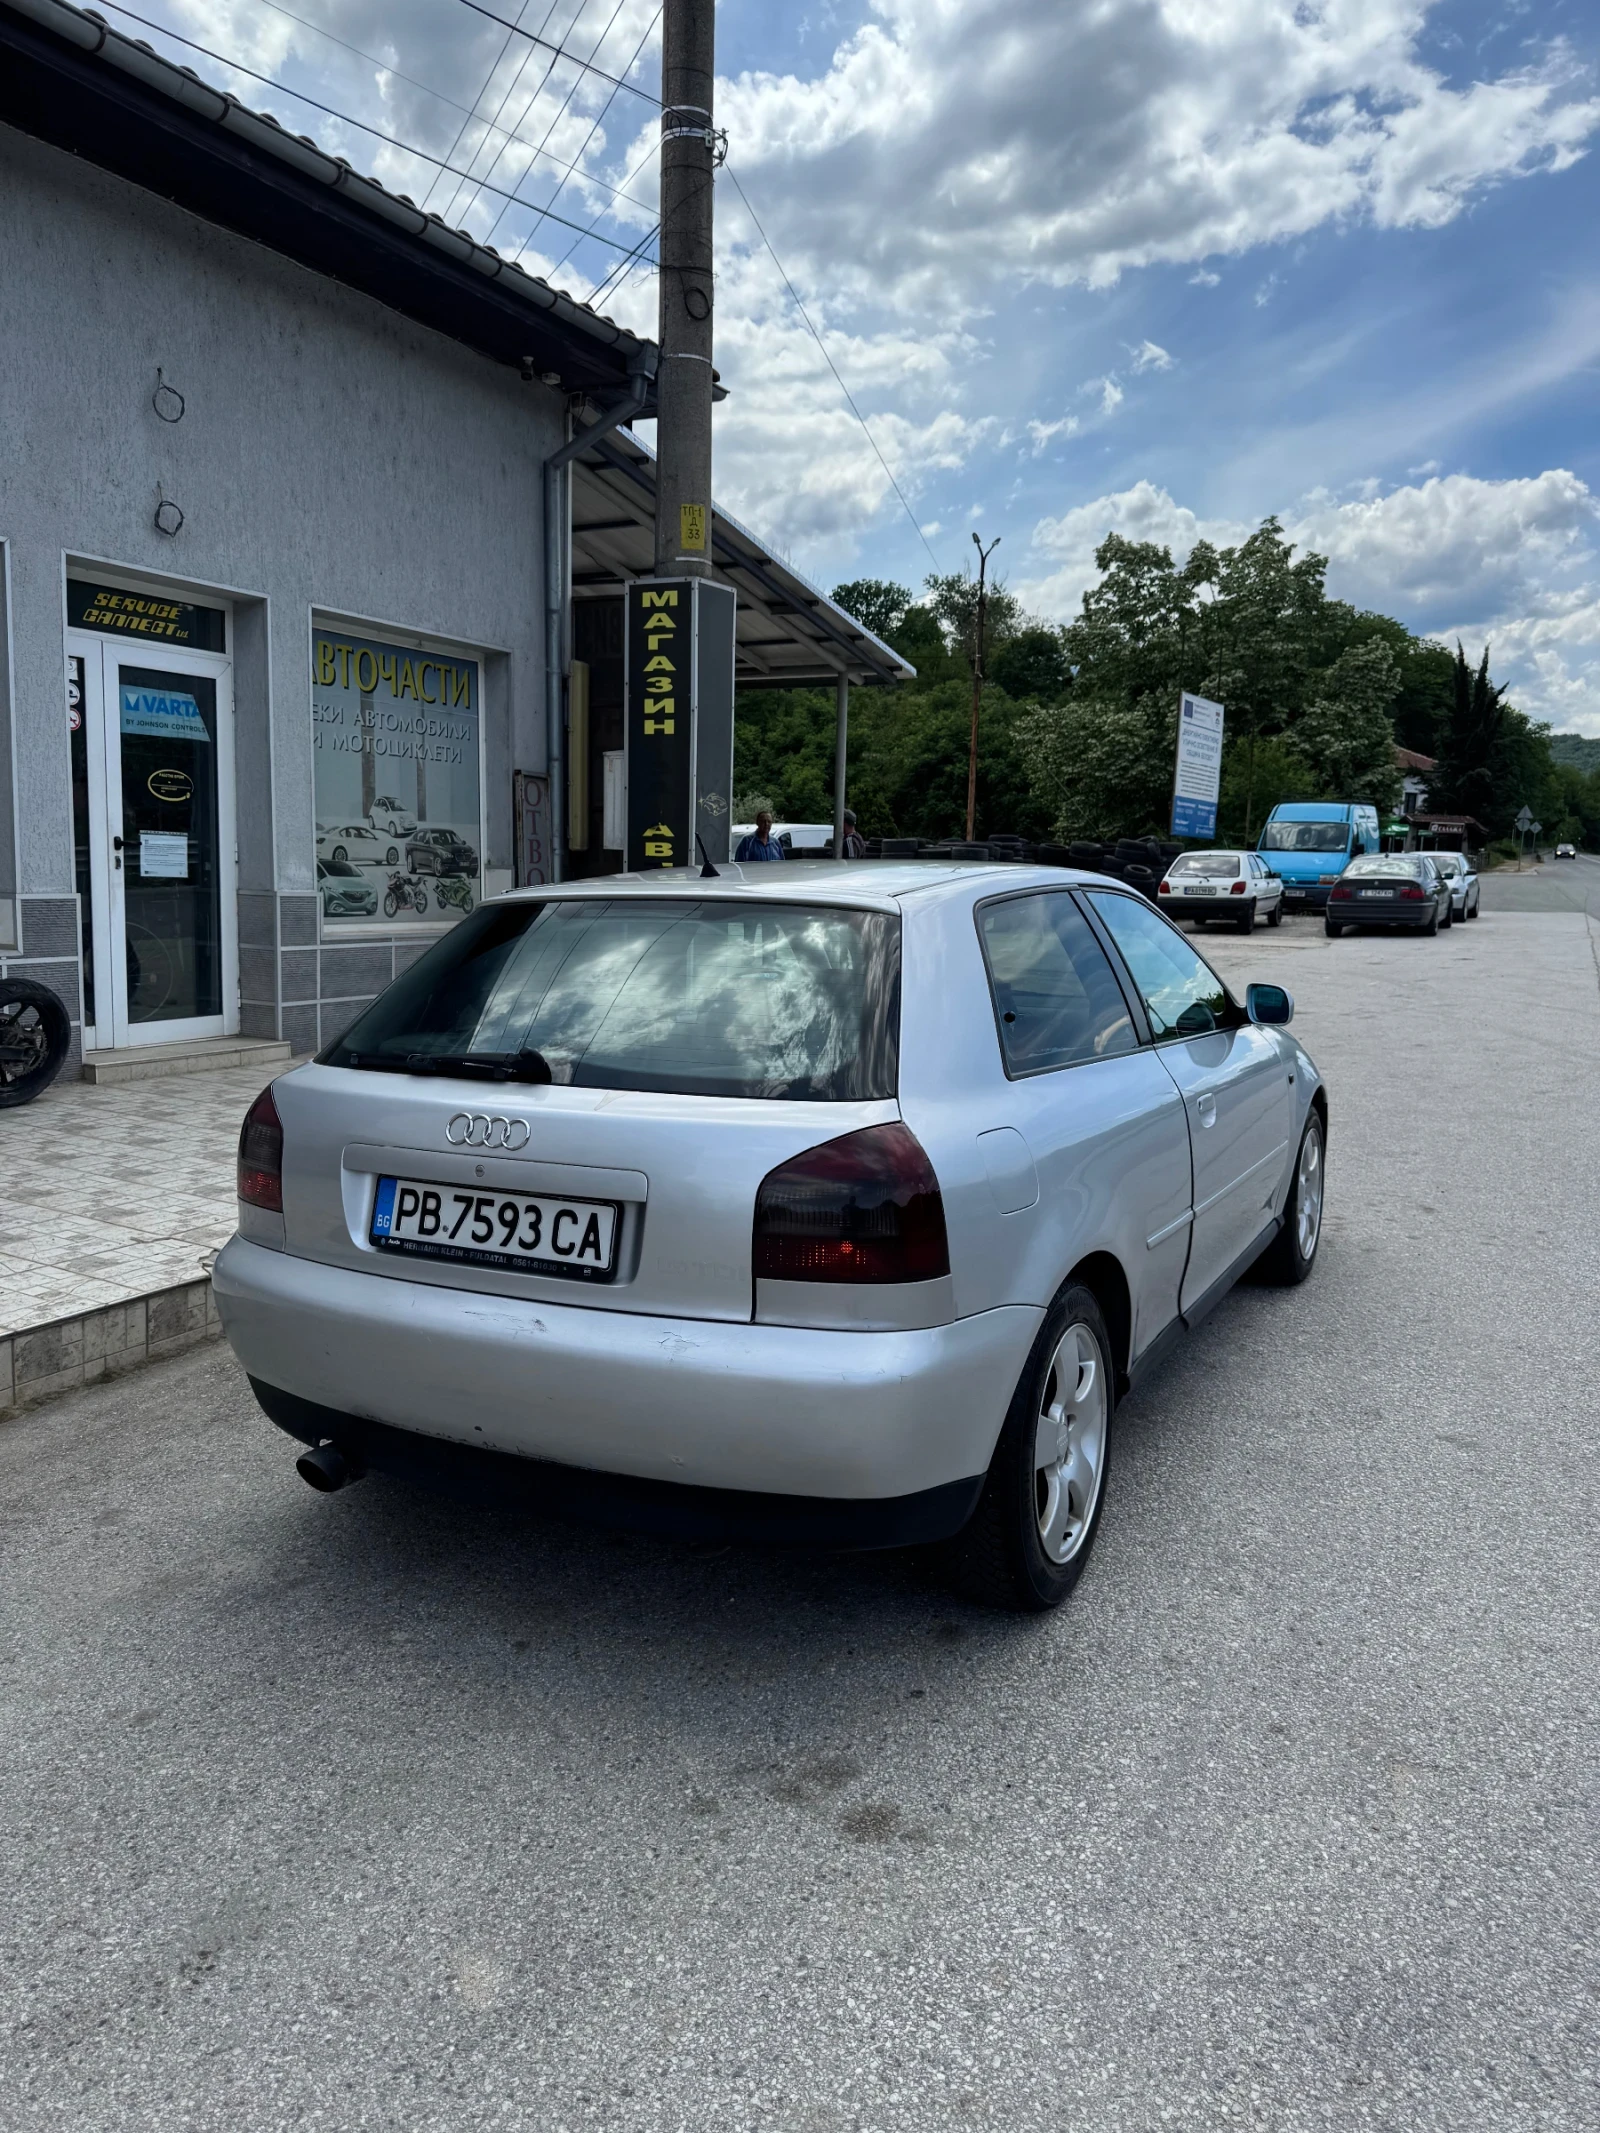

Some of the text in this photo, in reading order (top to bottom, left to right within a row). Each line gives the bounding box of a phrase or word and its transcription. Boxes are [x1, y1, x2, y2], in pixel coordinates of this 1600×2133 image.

[688, 529, 700, 539] 33
[94, 593, 183, 620] SERVICE
[642, 590, 678, 735] МАГАЗИН
[142, 695, 200, 717] VARTA
[136, 720, 169, 729] JOHNSON
[171, 723, 206, 733] CONTROLS
[353, 707, 471, 741] АВТОМОБИЛИ
[333, 732, 463, 764] МОТОЦИКЛЕТИ
[376, 1214, 390, 1228] BG
[440, 1246, 464, 1257] KLEIN
